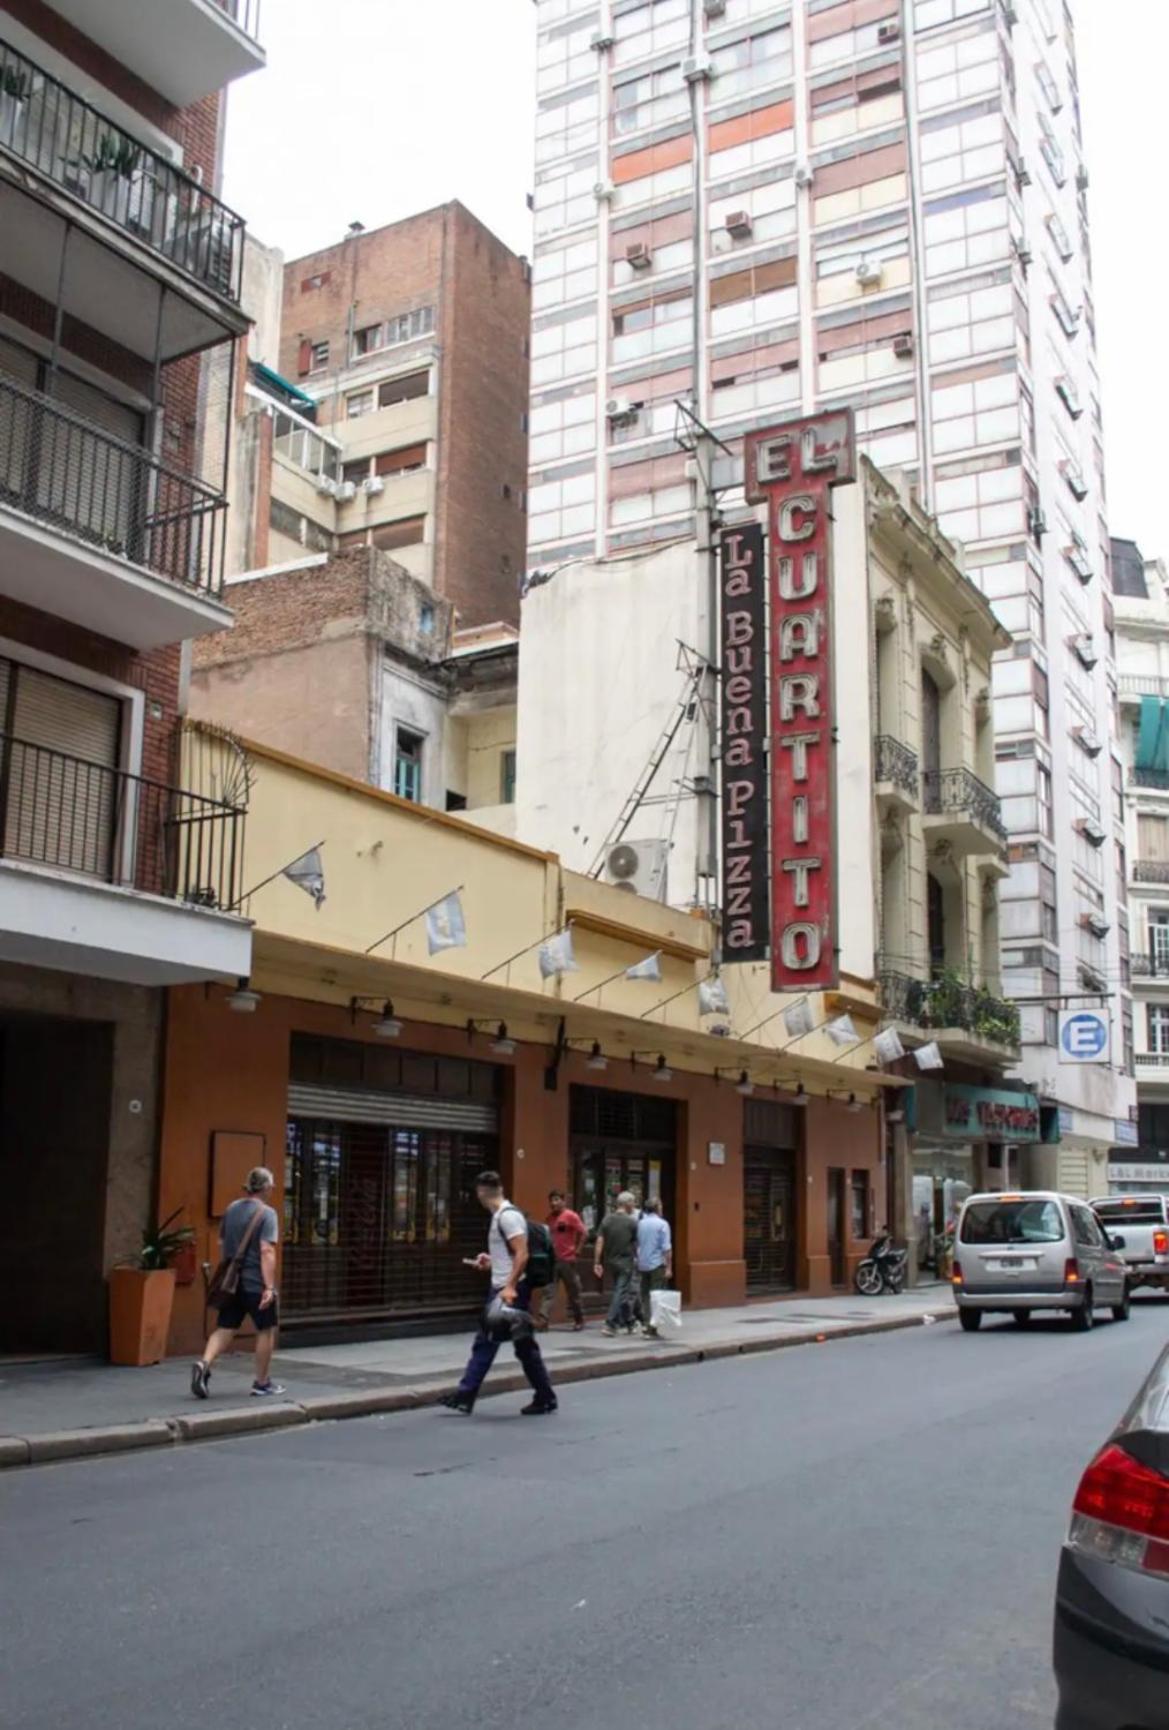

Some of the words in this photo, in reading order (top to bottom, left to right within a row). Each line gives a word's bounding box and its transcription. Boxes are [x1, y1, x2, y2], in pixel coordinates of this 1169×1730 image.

[757, 425, 838, 484] EL
[725, 534, 752, 597] La
[725, 611, 755, 766] Buena
[778, 495, 822, 971] CUARTITO
[726, 780, 755, 948] Pizza
[1069, 1021, 1099, 1052] E
